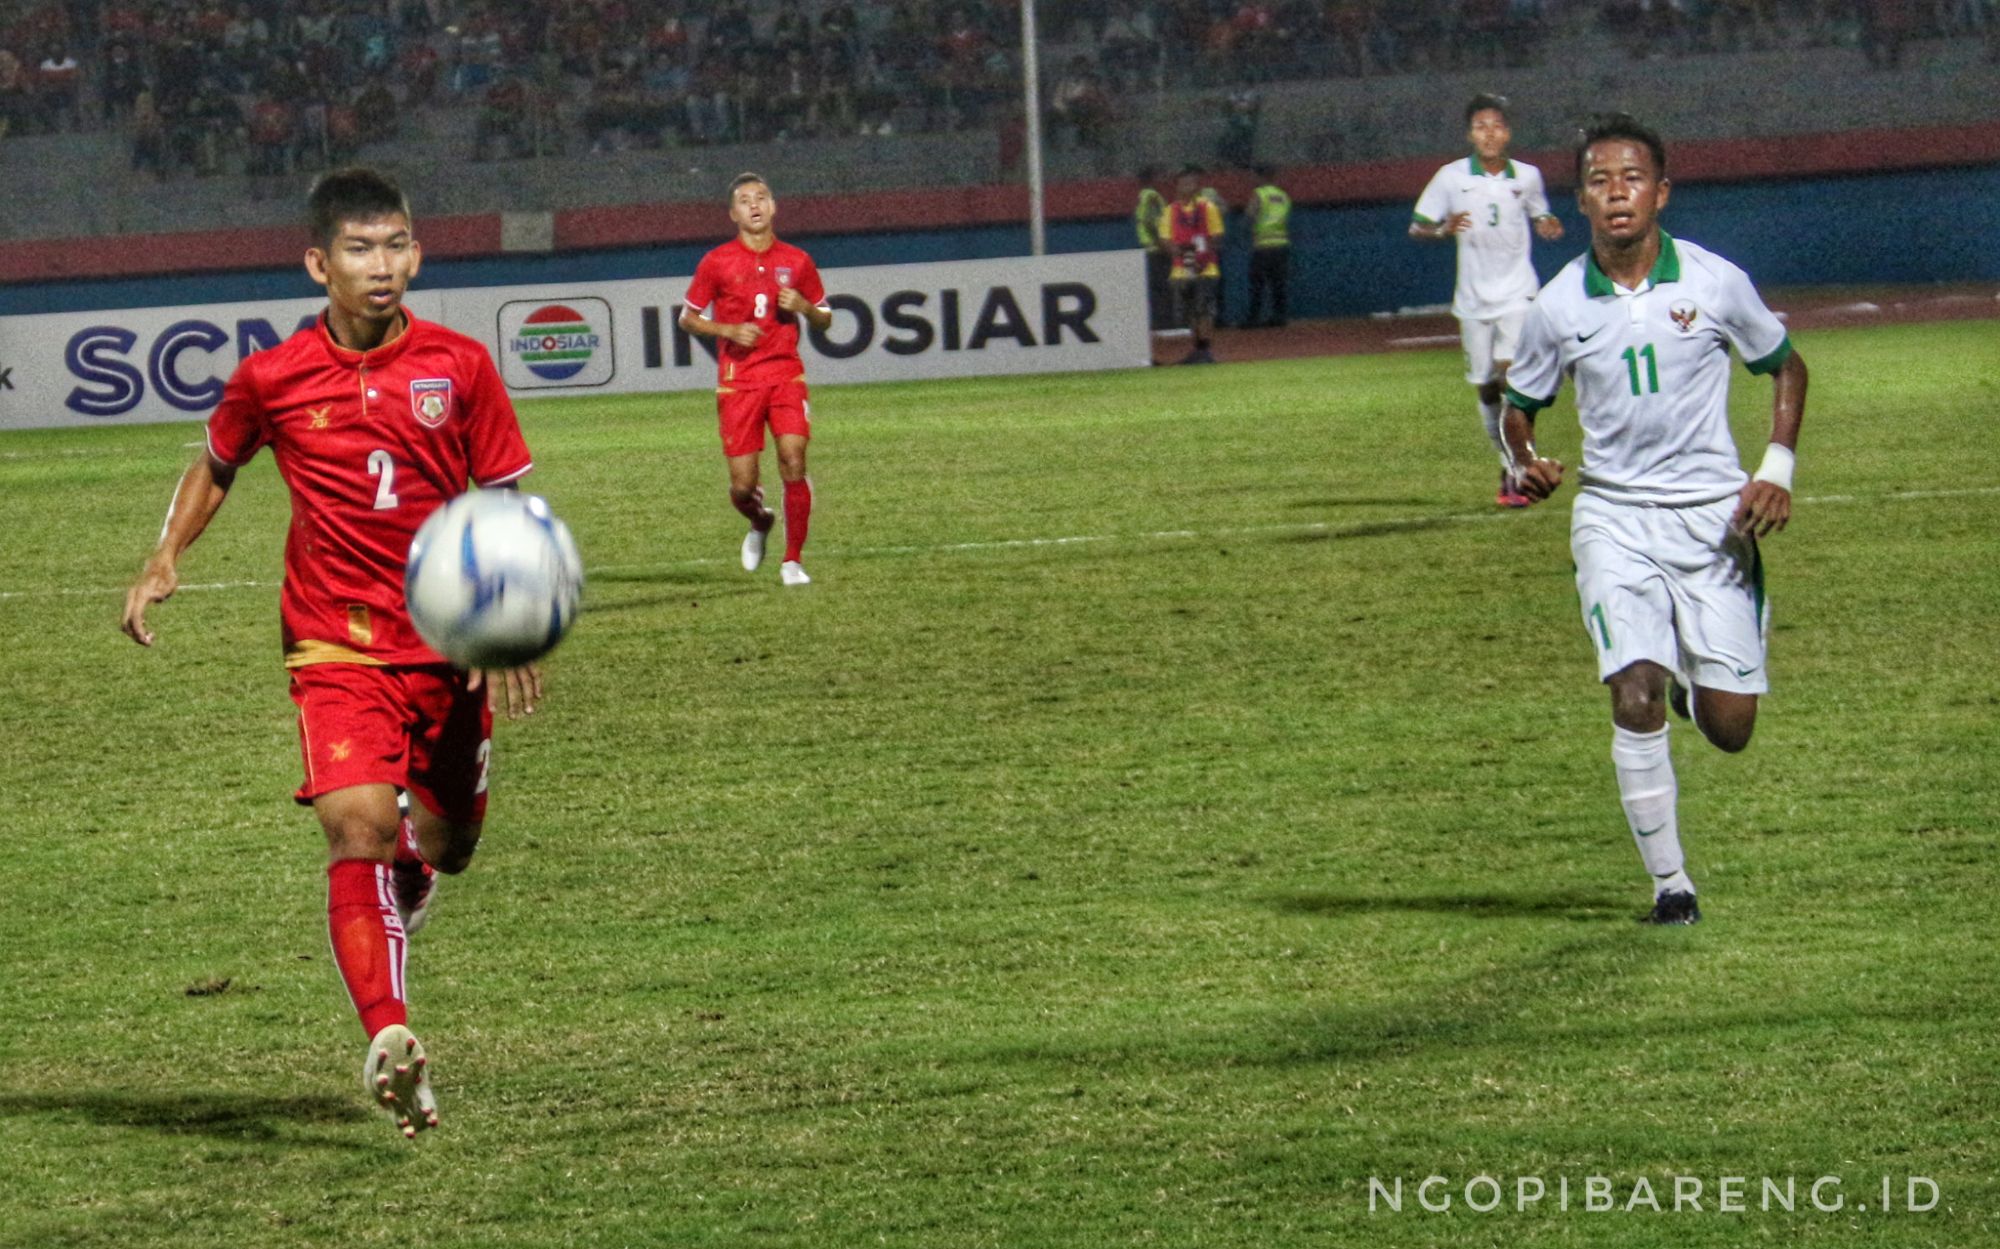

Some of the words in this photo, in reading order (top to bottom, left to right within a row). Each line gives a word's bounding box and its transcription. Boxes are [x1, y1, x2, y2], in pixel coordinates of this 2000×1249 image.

[1487, 202, 1500, 227] 3
[641, 281, 1101, 368] INOSIAR
[753, 293, 769, 319] 8
[510, 334, 600, 352] INDOSIAR
[1620, 342, 1660, 397] 11
[367, 449, 399, 510] 2
